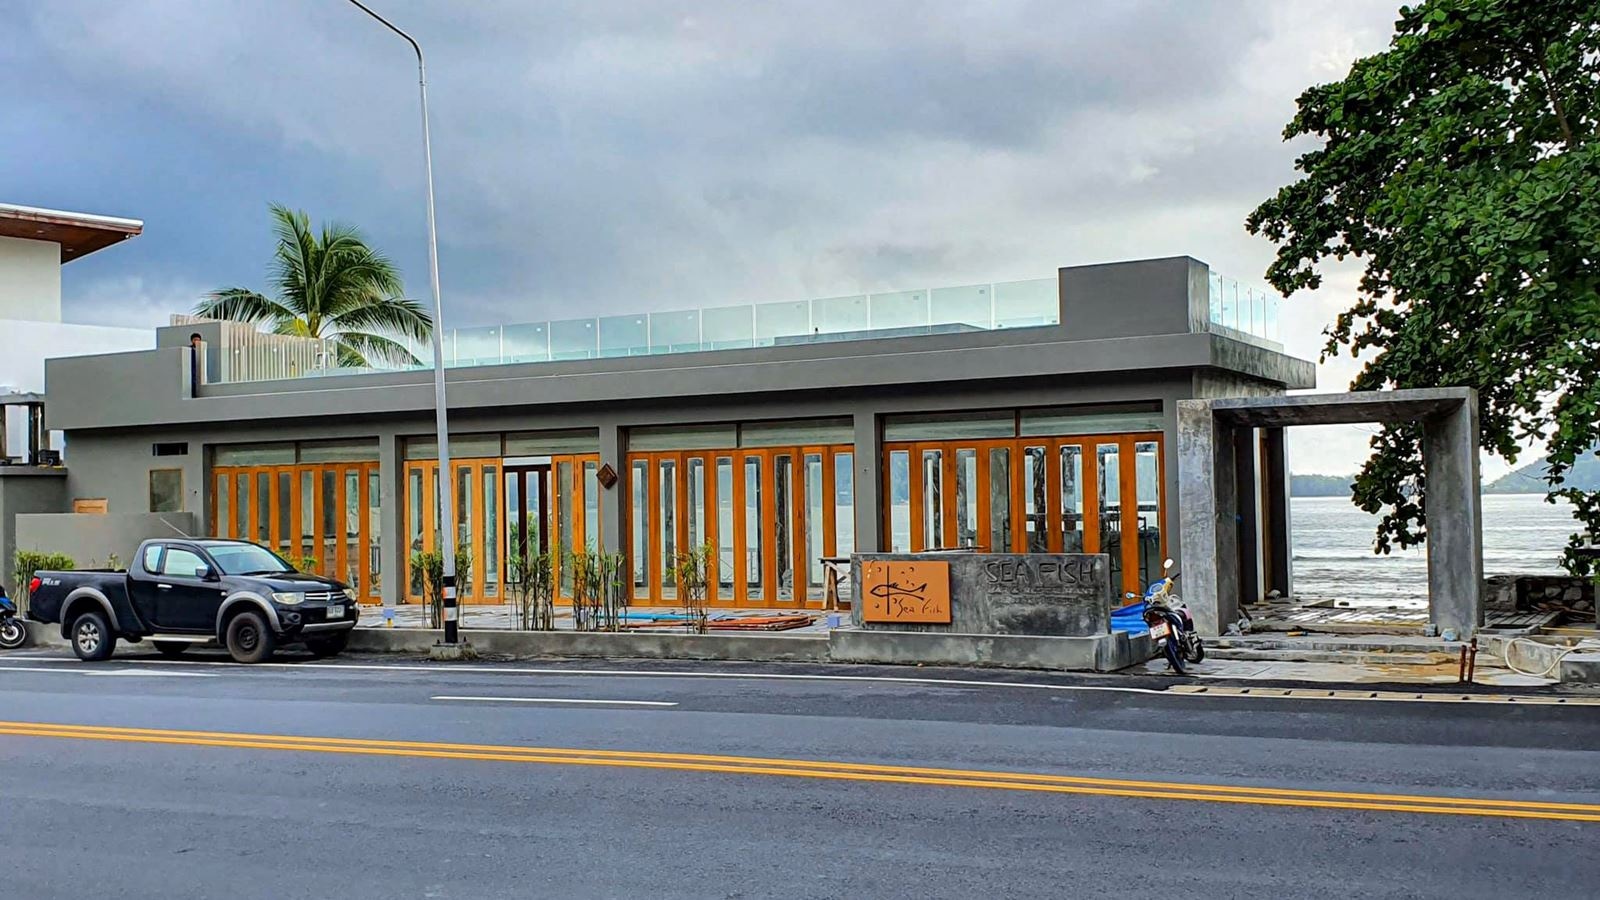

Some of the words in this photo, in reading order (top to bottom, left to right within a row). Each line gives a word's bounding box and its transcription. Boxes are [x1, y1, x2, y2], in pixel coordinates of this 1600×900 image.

[984, 562, 1031, 583] SEA
[1039, 562, 1093, 584] FISH
[896, 598, 915, 618] Sea
